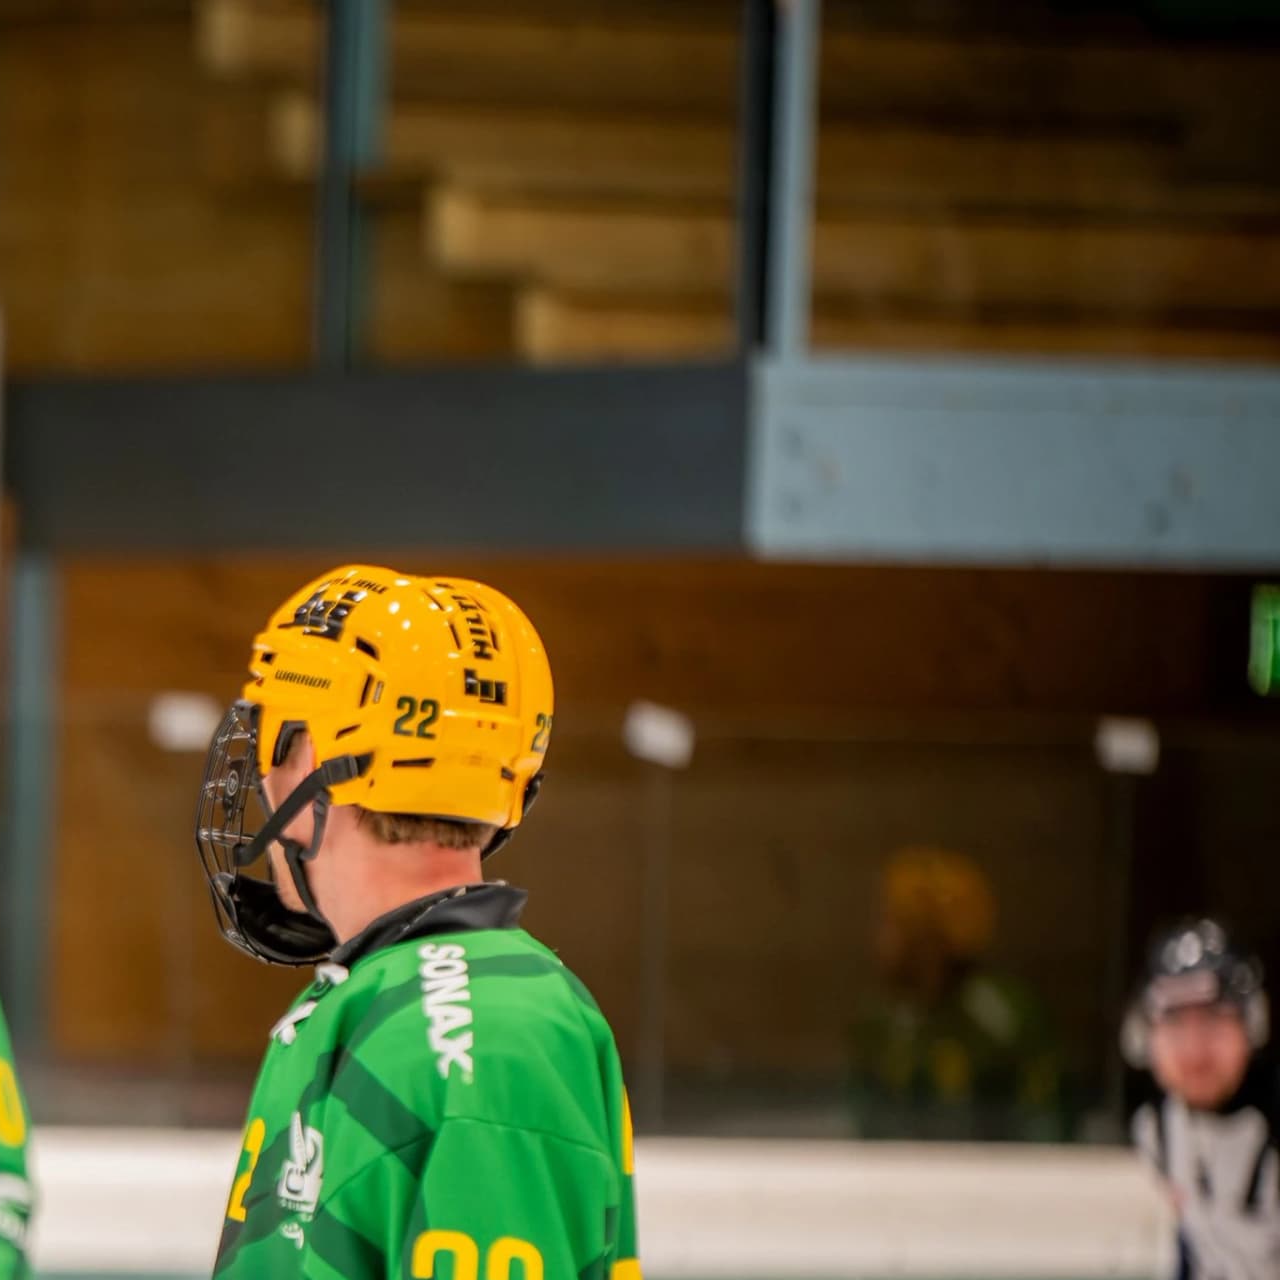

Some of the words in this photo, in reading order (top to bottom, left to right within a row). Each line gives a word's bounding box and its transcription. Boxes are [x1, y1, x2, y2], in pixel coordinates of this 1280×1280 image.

[275, 669, 332, 690] WARRIOR
[393, 696, 440, 739] 22
[418, 942, 474, 1080] SONAX
